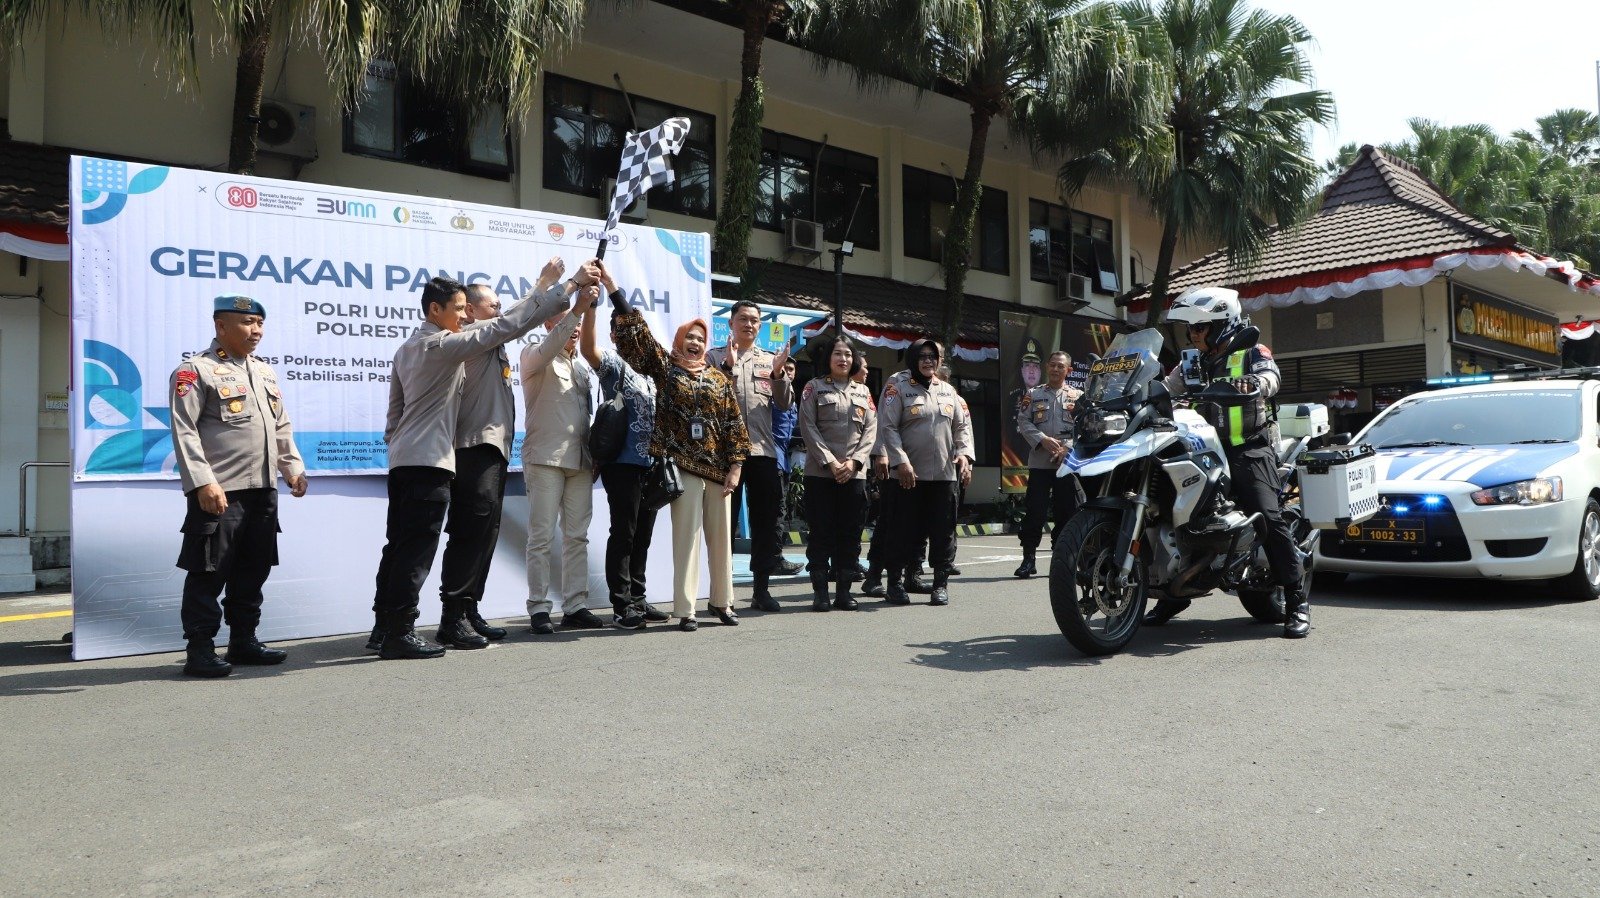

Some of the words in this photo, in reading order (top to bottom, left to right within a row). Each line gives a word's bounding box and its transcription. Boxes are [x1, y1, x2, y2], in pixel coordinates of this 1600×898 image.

[228, 187, 257, 208] 80
[488, 225, 536, 237] MASYARAKAT
[489, 219, 510, 228] POLRI
[511, 221, 535, 230] UNTUK
[150, 246, 373, 290] GERAKAN
[304, 302, 368, 318] POLRI
[375, 306, 427, 321] UNTU
[283, 354, 347, 367] Polresta
[351, 357, 394, 369] Malan
[286, 370, 364, 383] Stabilisasi
[1182, 474, 1201, 488] GS
[1348, 468, 1364, 482] POLISI
[1389, 520, 1396, 528] X
[1370, 530, 1395, 540] 1002
[1403, 531, 1416, 541] 33
